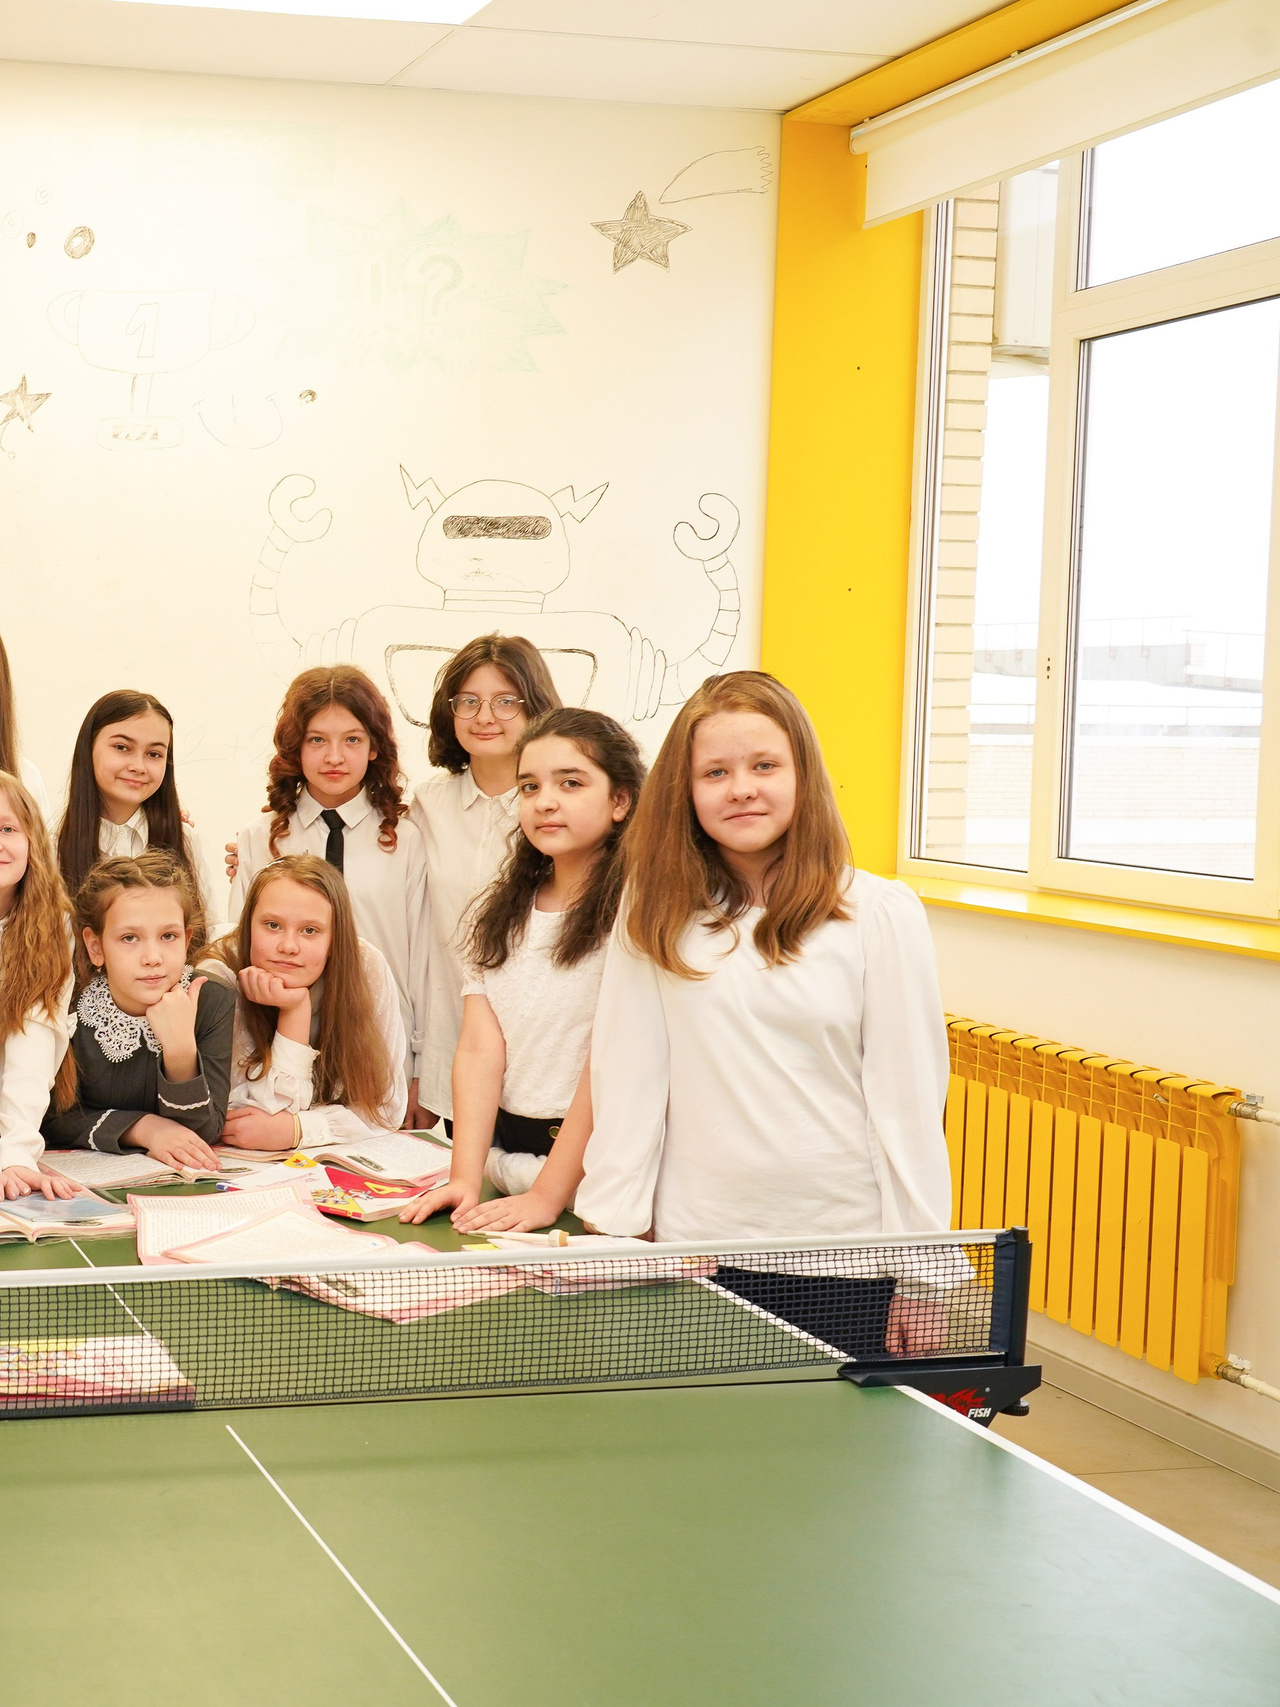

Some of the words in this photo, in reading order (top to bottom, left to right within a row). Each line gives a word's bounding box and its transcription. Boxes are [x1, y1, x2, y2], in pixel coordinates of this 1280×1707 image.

[125, 302, 160, 359] 1
[363, 1181, 408, 1195] 4
[967, 1407, 992, 1418] FISH
